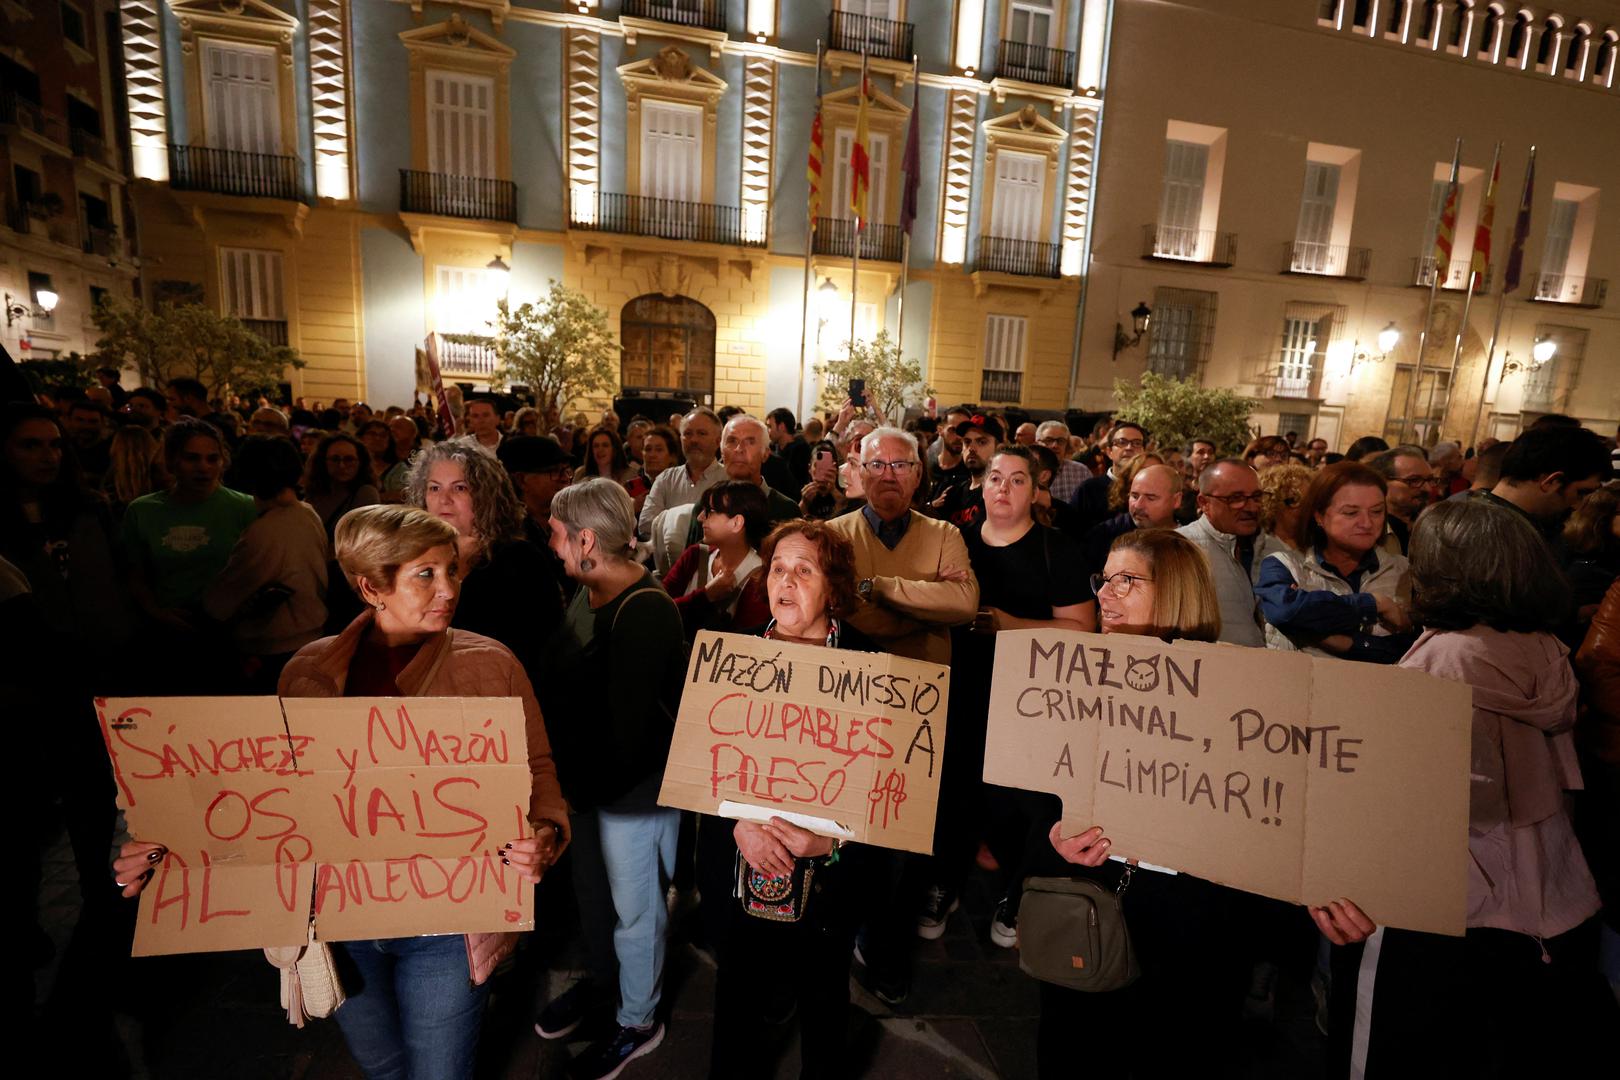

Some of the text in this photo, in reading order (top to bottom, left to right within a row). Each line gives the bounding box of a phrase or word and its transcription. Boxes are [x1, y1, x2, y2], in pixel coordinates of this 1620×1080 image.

[693, 637, 945, 716] MAZÓN DIMISSIÓ
[368, 704, 508, 765] MAZÓN
[708, 693, 894, 758] CULPABLES
[1016, 688, 1363, 773] CRIMINAL, PONTE
[205, 774, 488, 841] OS VAIS
[1052, 743, 1284, 827] A LIMPIAR!!
[151, 850, 250, 931] AL
